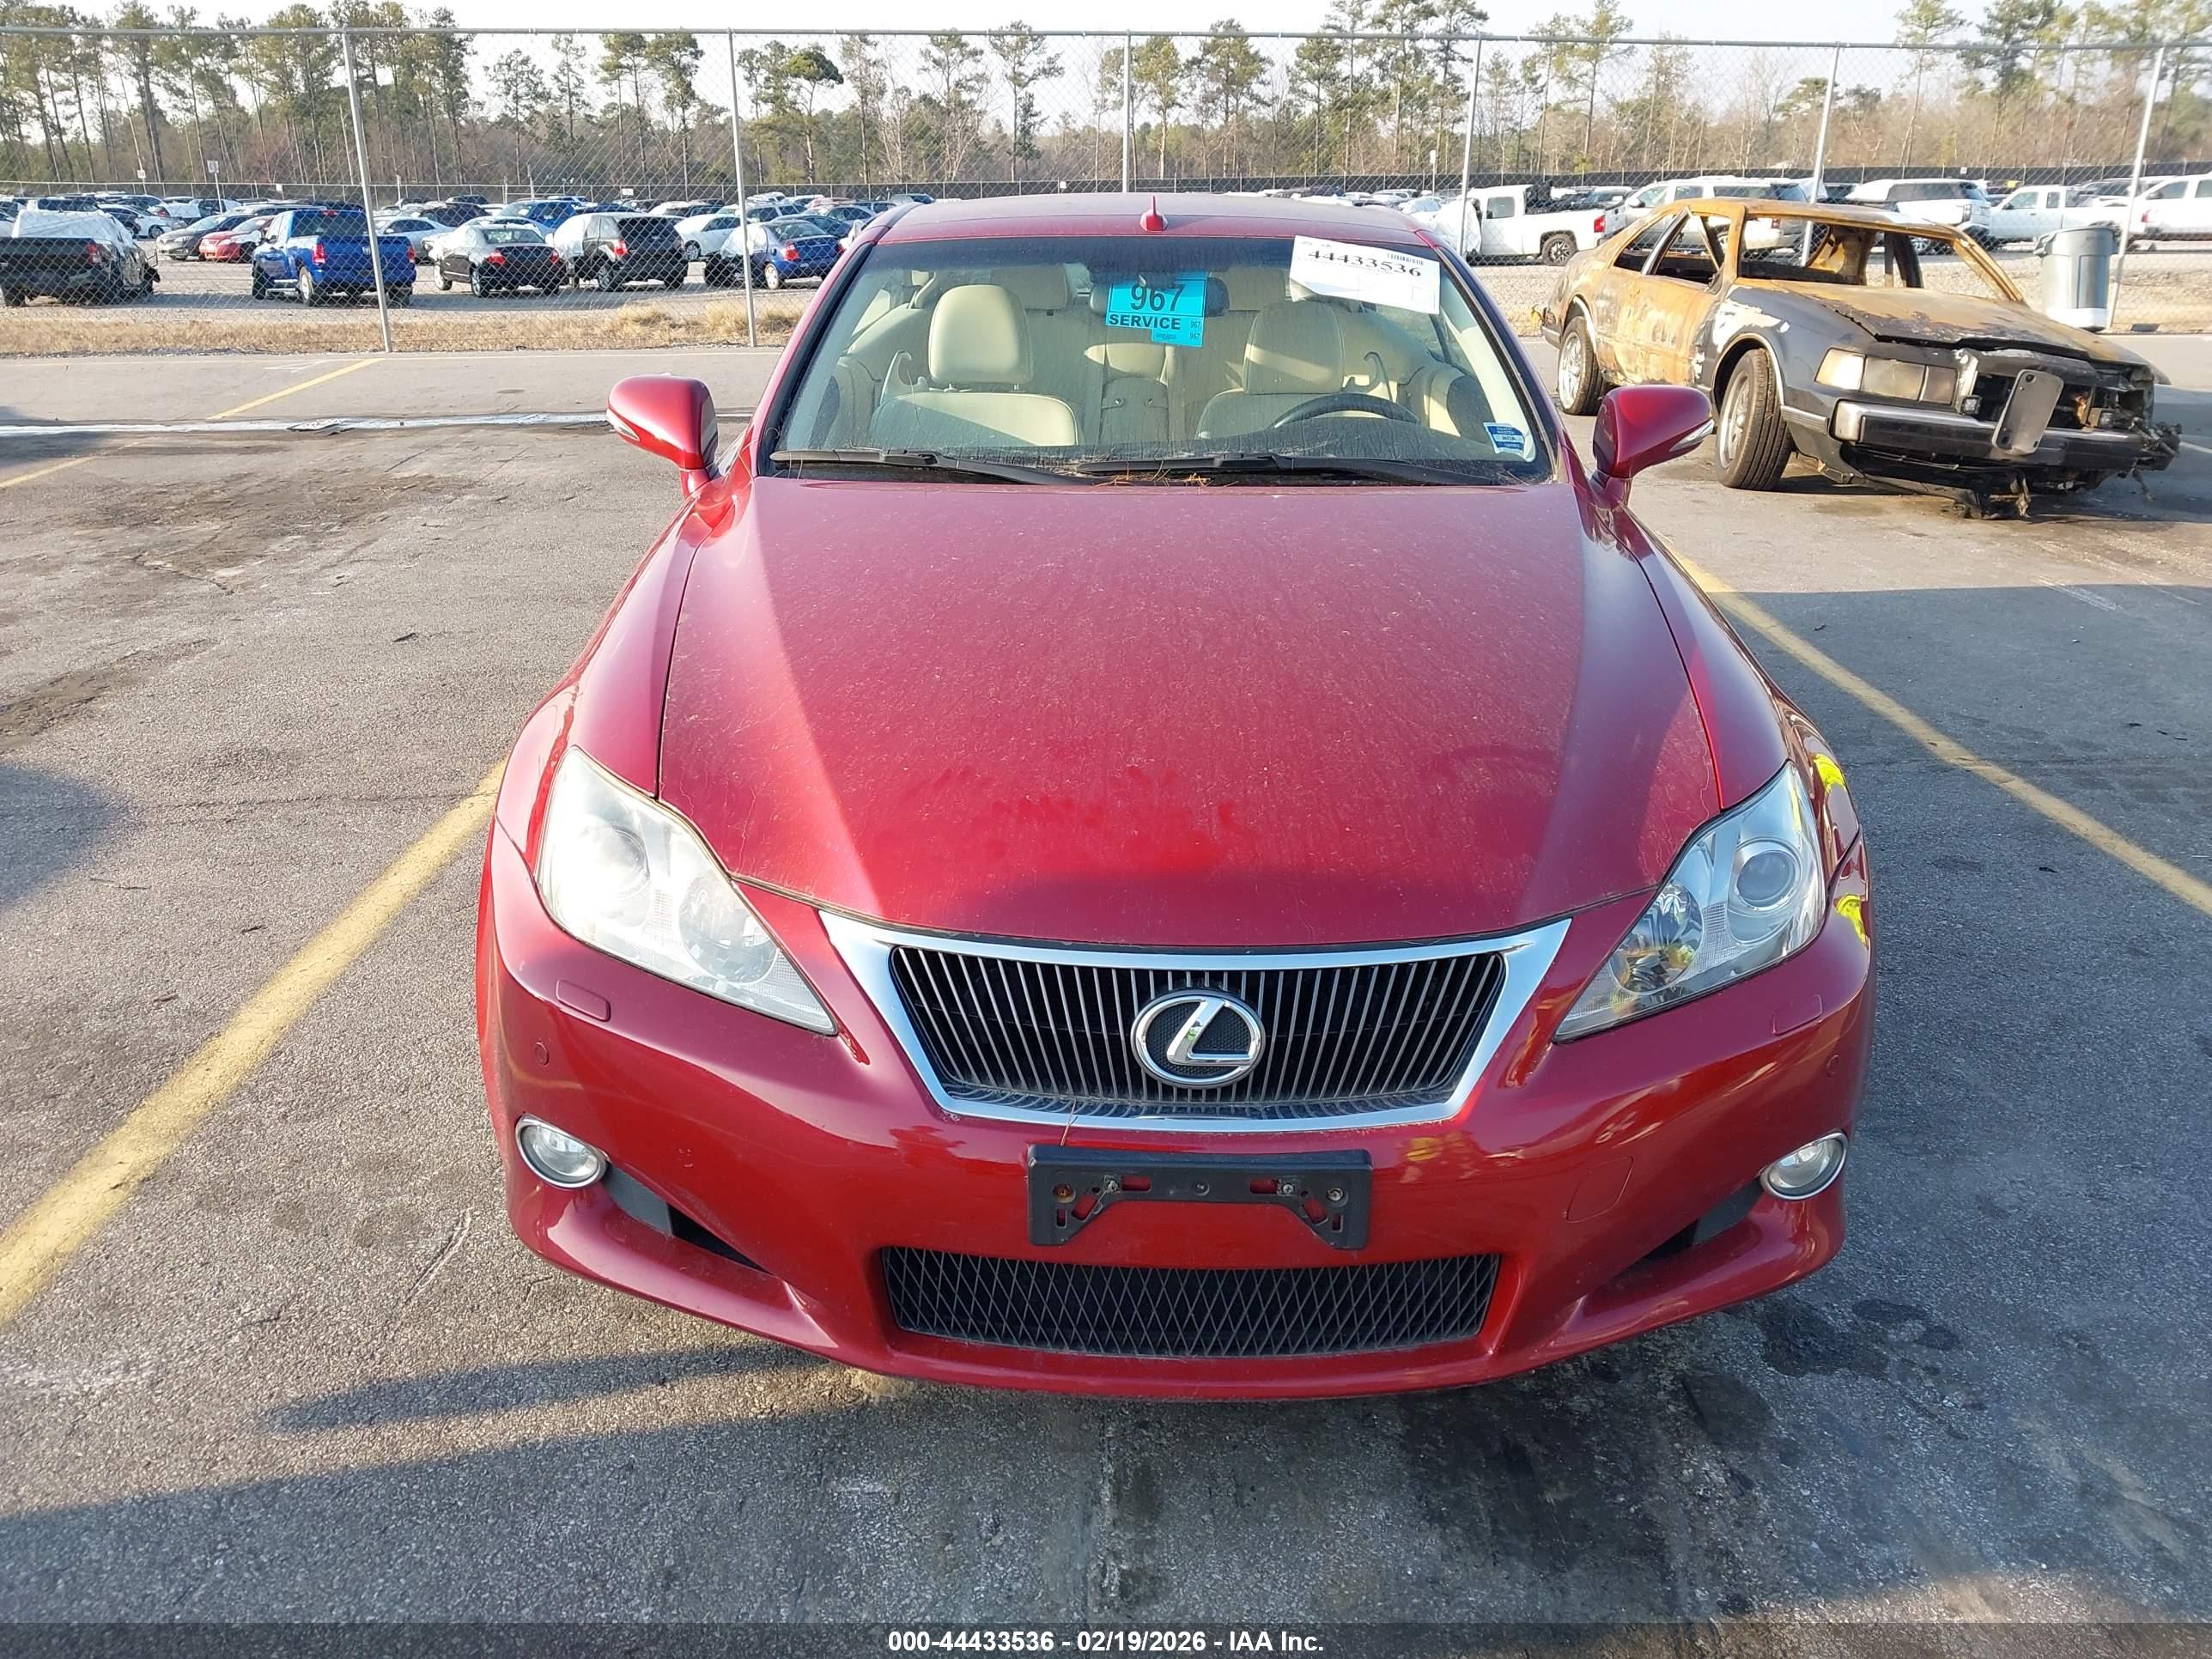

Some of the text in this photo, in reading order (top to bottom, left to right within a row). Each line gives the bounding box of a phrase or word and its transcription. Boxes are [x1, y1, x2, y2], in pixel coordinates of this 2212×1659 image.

[1308, 250, 1422, 277] 44433536
[1130, 282, 1186, 312] 967
[1109, 313, 1181, 331] SERVICE
[1190, 320, 1201, 329] 967
